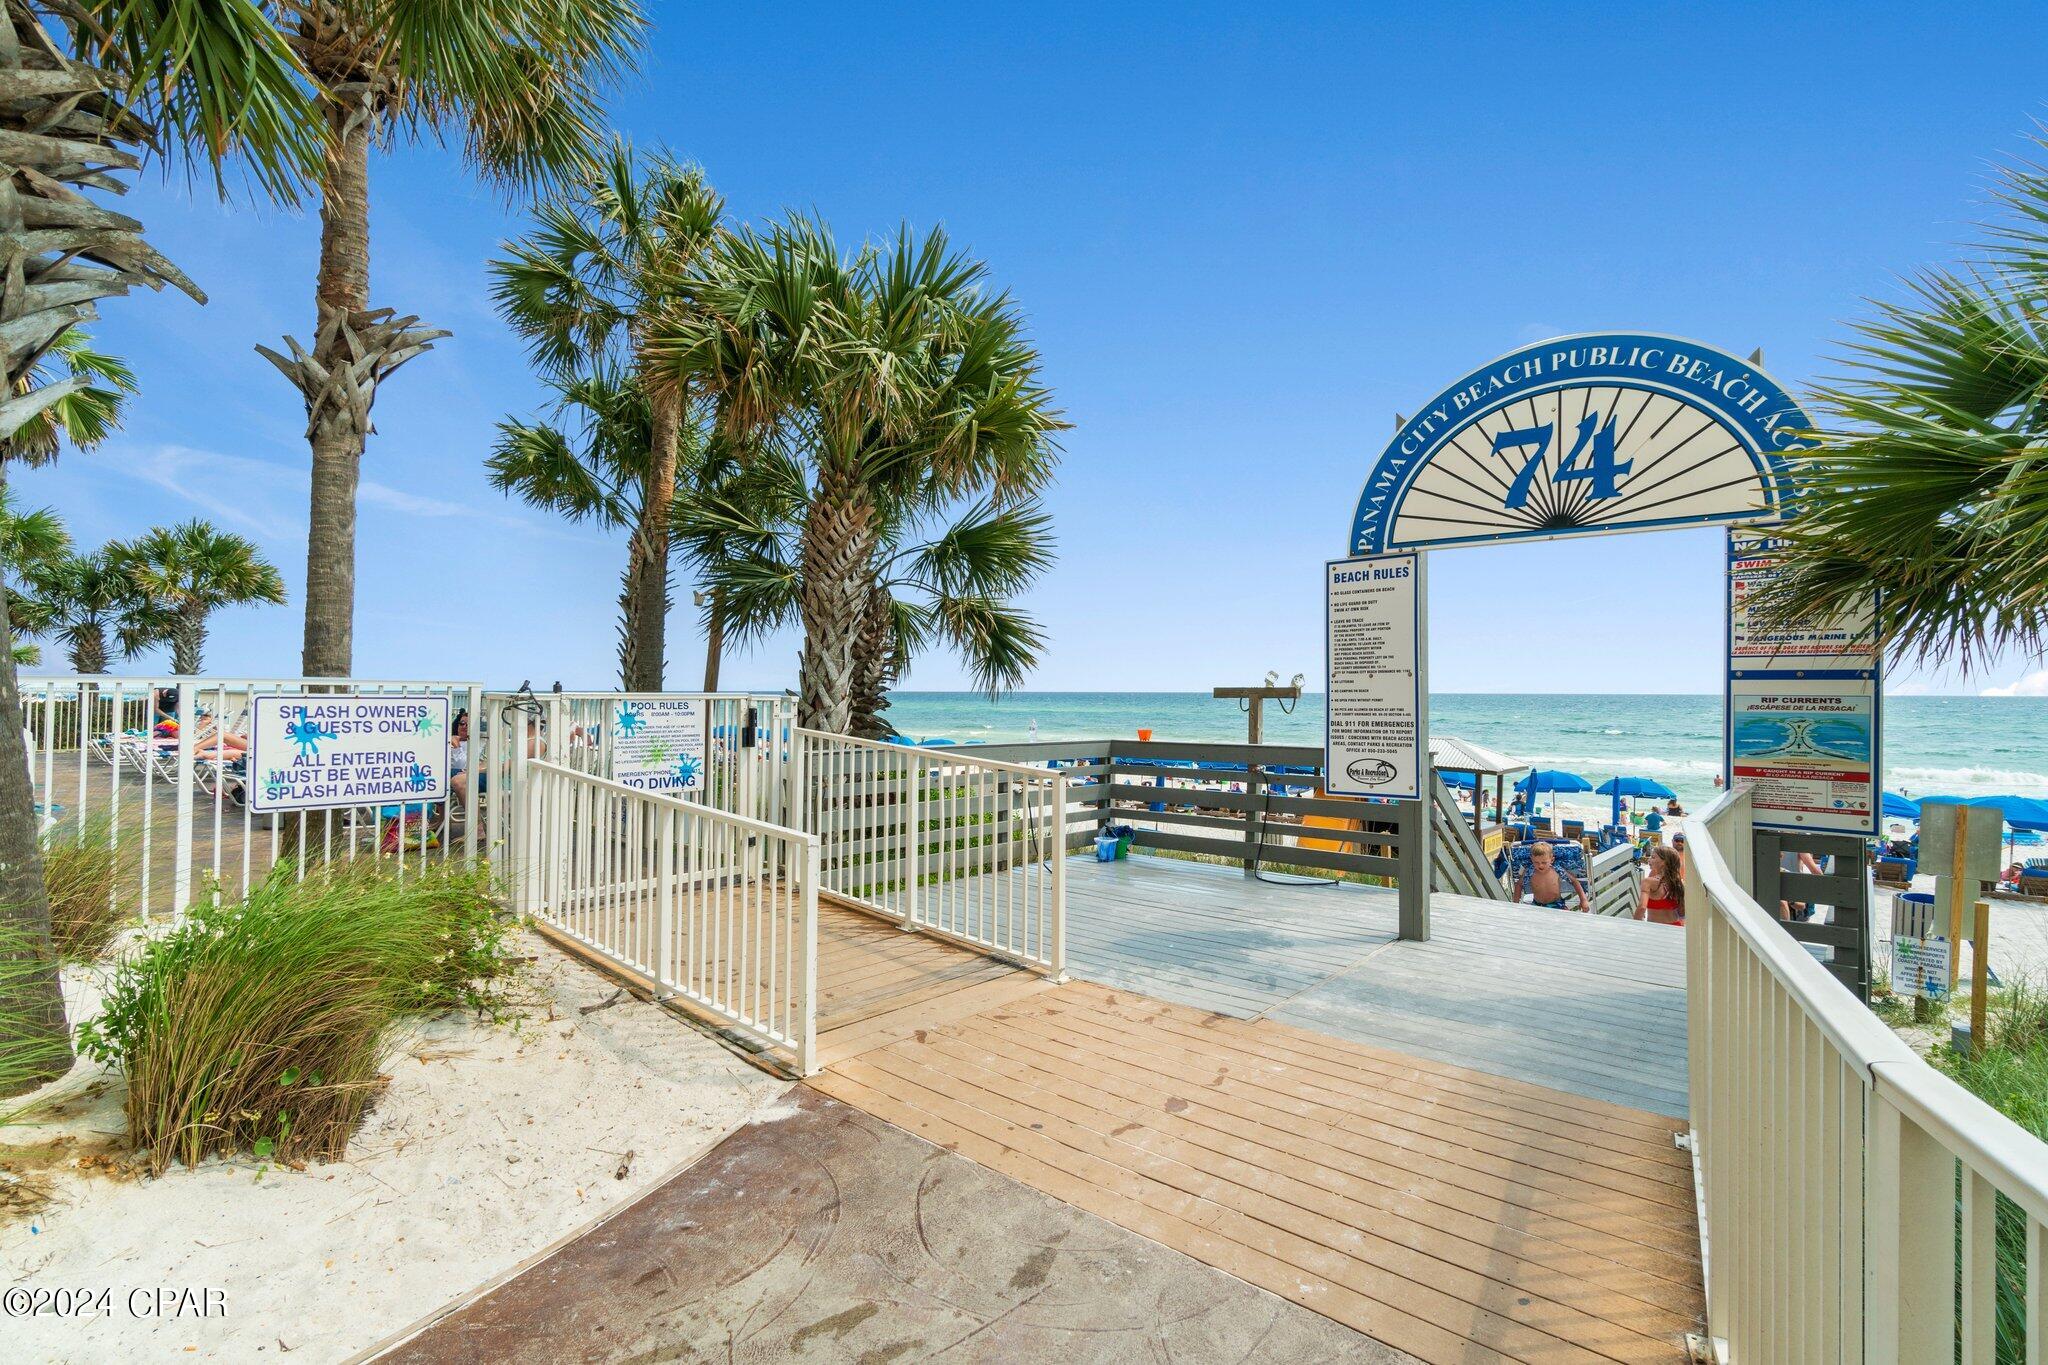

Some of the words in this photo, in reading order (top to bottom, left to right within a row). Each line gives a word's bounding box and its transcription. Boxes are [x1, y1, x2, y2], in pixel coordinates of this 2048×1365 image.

[1358, 458, 1407, 550] PANAMA
[1401, 404, 1450, 455] CITY
[1453, 357, 1542, 410] BEACH
[1552, 346, 1664, 372] PUBLIC
[1666, 353, 1768, 414] BEACH
[1491, 410, 1635, 509] 74
[1734, 541, 1761, 551] NO
[1736, 560, 1772, 568] SWIM
[1334, 571, 1369, 583] BEACH
[1374, 567, 1409, 580] RULES
[279, 705, 350, 719] SPLASH
[356, 705, 428, 718] OWNERS
[285, 722, 296, 735] &
[303, 720, 373, 735] GUESTS
[378, 720, 421, 734] ONLY
[292, 754, 326, 768] ALL
[331, 751, 416, 766] ENTERING
[270, 769, 322, 784] MUST
[327, 768, 350, 782] BE
[355, 765, 432, 781] WEARING
[623, 779, 644, 789] NO
[649, 775, 696, 789] DIVING
[266, 784, 338, 800] SPLASH
[343, 779, 437, 796] ARMBANDS
